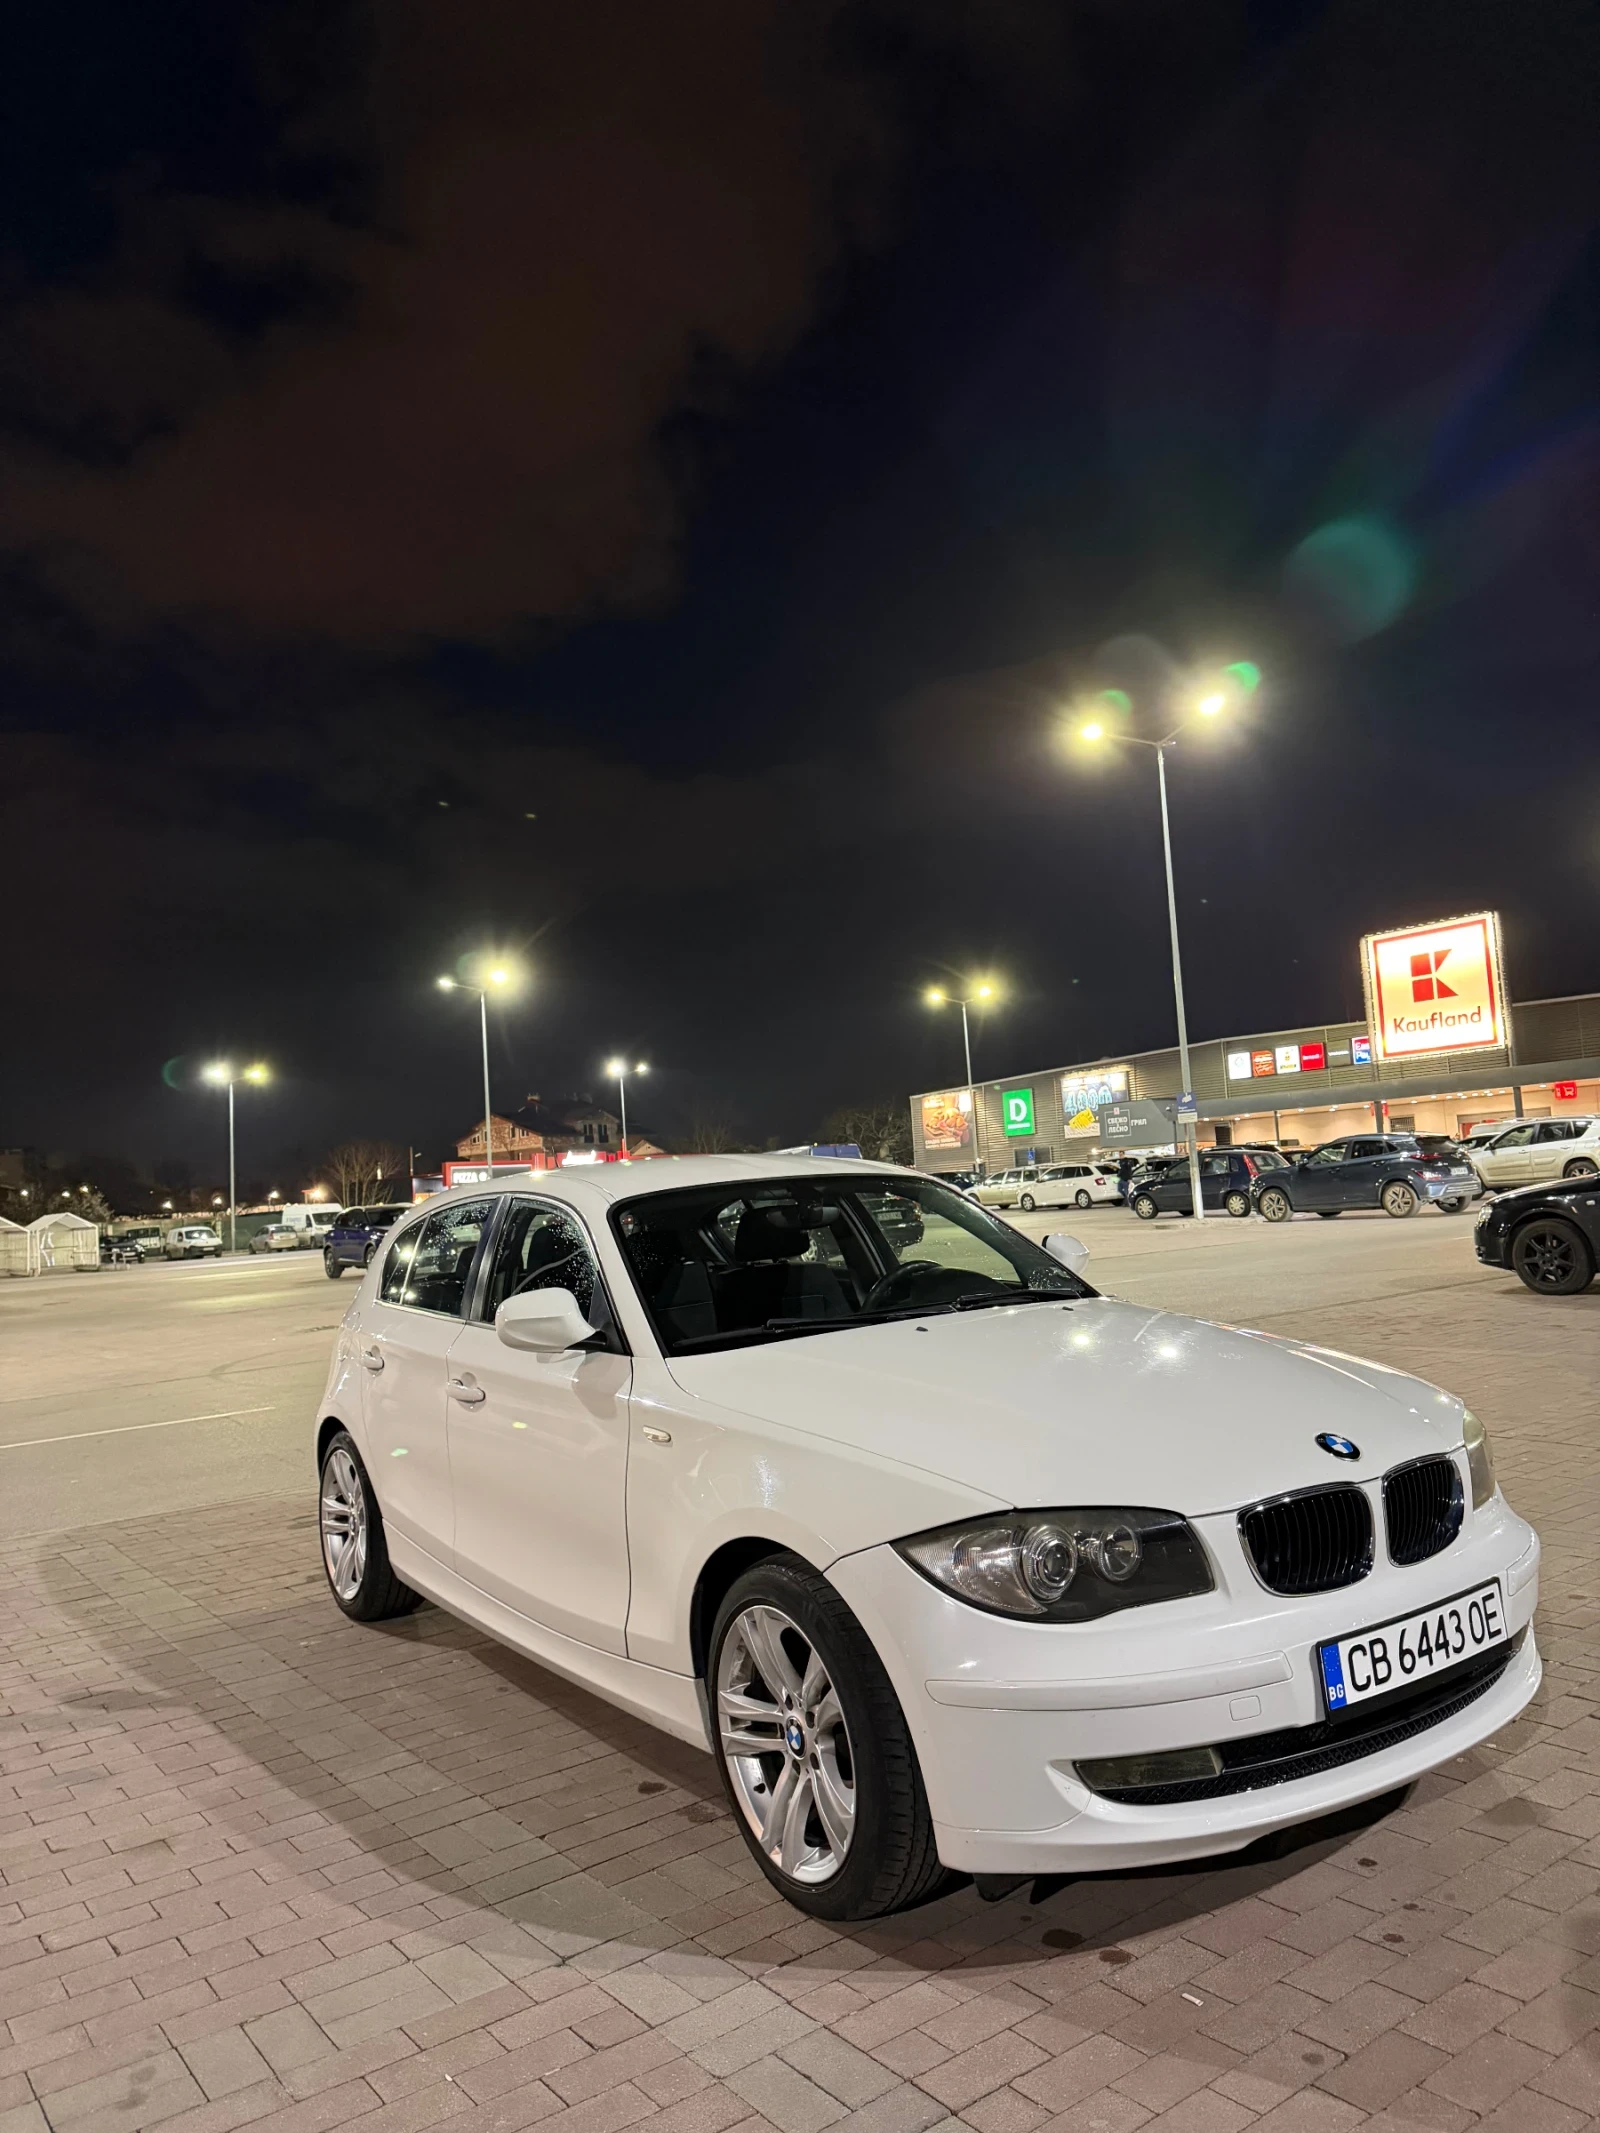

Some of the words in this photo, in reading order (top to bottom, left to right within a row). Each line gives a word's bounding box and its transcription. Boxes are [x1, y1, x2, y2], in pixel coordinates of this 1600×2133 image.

[1393, 1005, 1482, 1034] Kaufland
[1008, 1098, 1027, 1122] D
[1108, 1125, 1128, 1133] ЛЕСНО
[1130, 1118, 1147, 1127] ГРИЛ
[1348, 1637, 1392, 1692] CB
[1399, 1609, 1466, 1675] 6443
[1468, 1592, 1502, 1644] OE
[1328, 1683, 1344, 1701] BG
